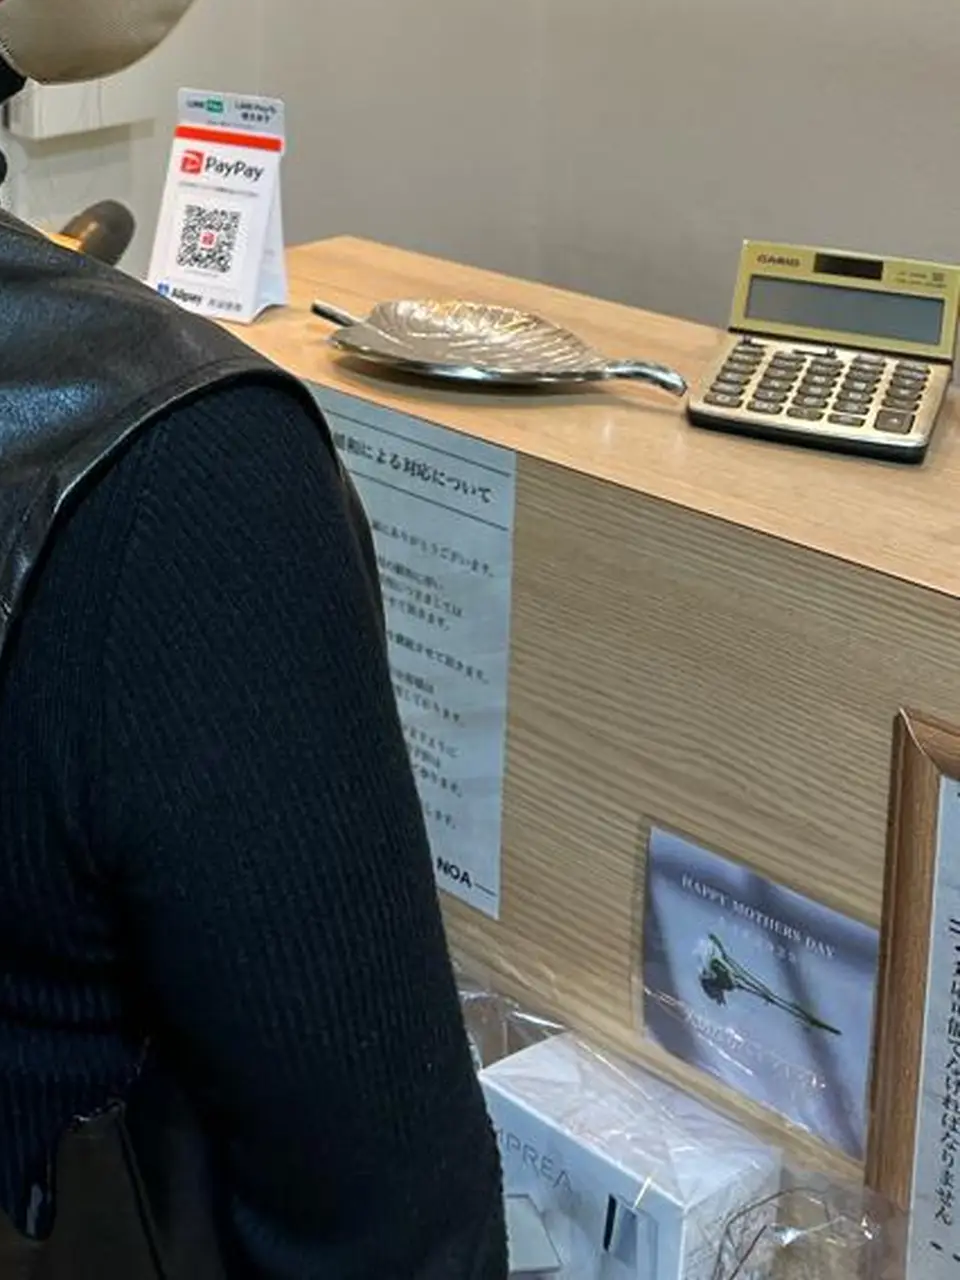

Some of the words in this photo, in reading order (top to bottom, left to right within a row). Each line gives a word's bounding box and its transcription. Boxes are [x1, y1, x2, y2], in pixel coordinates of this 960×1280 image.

[205, 156, 264, 181] PayPay
[437, 856, 472, 889] NOA
[681, 871, 728, 907] HAPPY
[732, 900, 800, 942] MOTHERS
[805, 936, 836, 961] DAY
